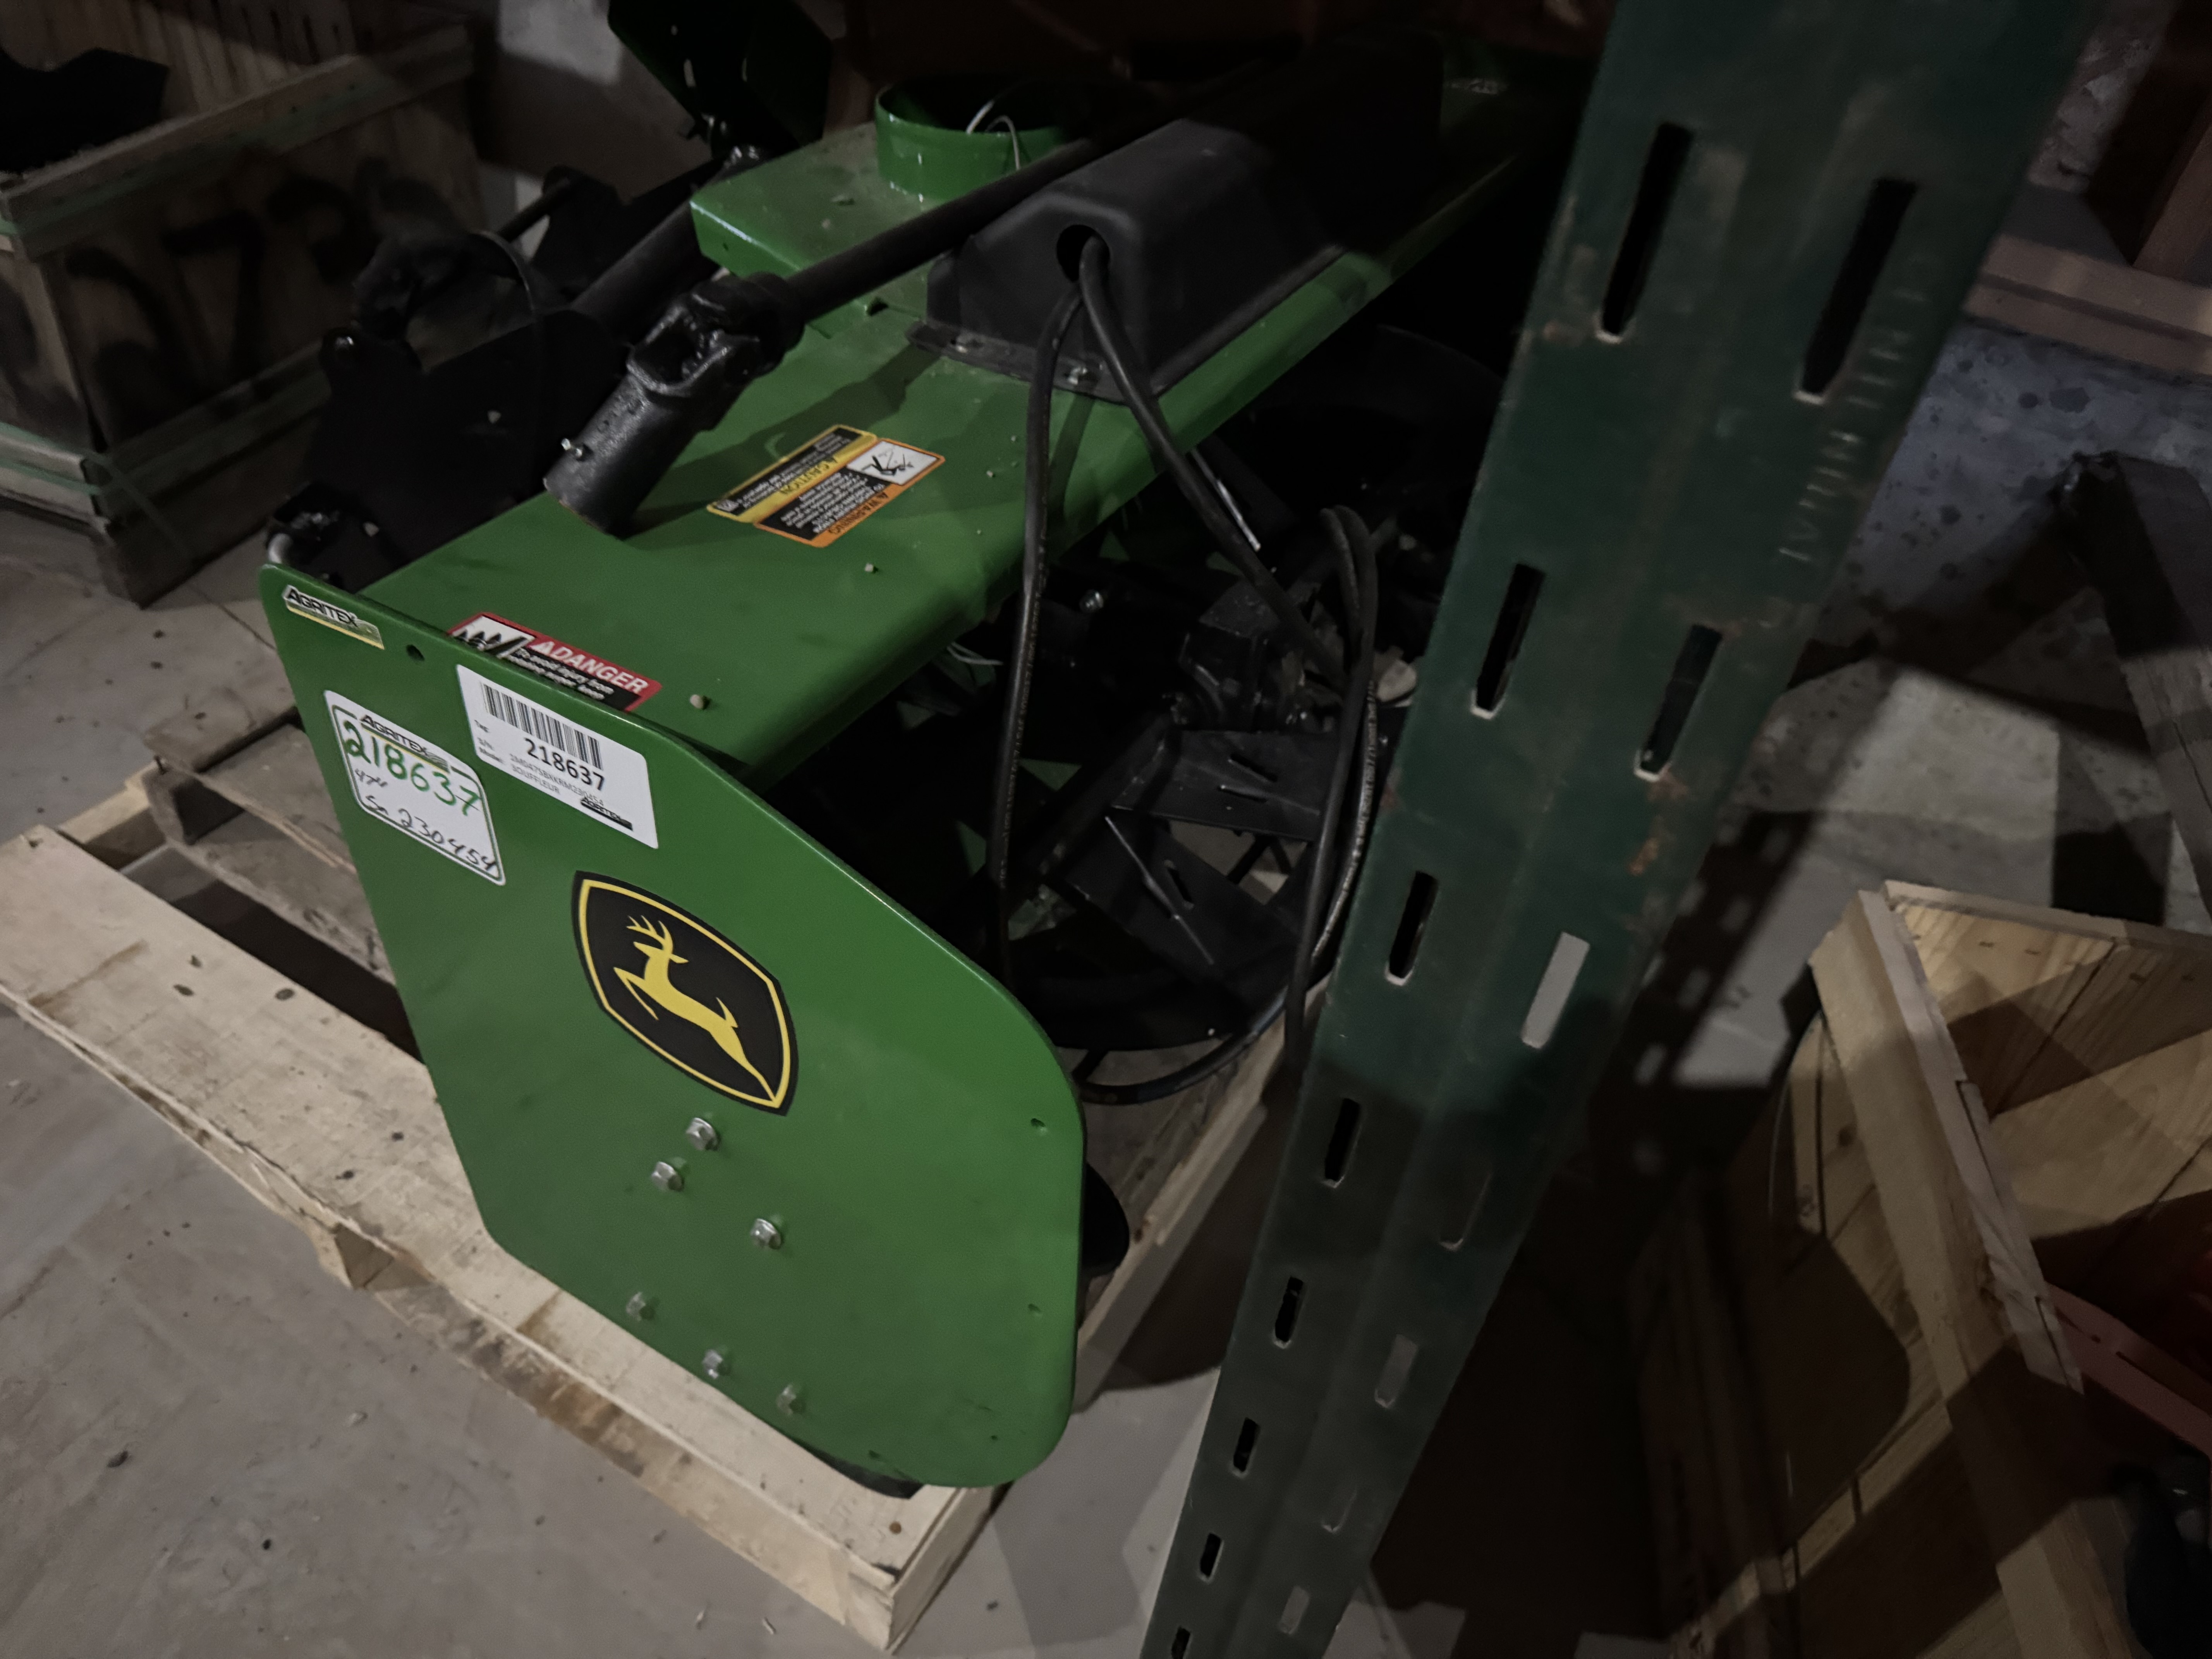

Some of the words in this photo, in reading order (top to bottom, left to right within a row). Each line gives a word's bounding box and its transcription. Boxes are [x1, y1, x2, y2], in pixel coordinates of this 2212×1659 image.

[288, 588, 358, 628] AGRITEX
[553, 646, 649, 694] DANGER
[360, 714, 429, 755] AGRITEX
[343, 720, 481, 816] 218637
[524, 737, 605, 792] 218637
[398, 808, 497, 871] 230454
